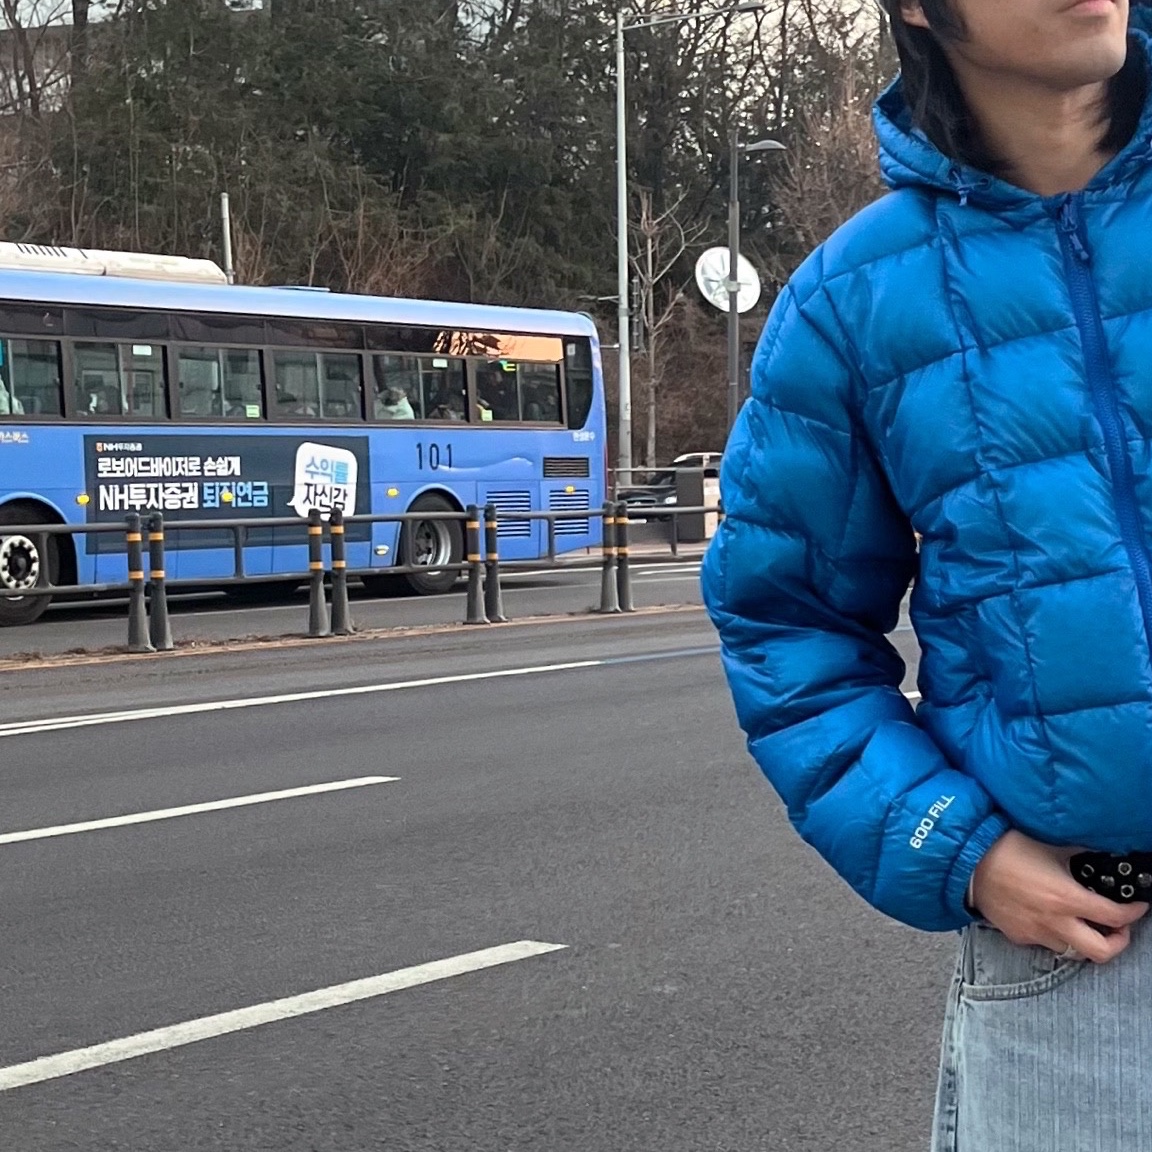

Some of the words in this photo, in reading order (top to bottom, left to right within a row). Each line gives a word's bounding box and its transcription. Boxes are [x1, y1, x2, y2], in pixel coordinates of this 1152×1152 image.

[97, 456, 202, 477] 로보어드바이저로
[203, 455, 241, 477] 손쉽게
[304, 456, 349, 485] 수익률
[416, 442, 453, 470] 101
[99, 481, 199, 511] NH투자증권
[202, 480, 269, 508] 퇴직연금
[303, 482, 348, 512] 자신감
[909, 817, 934, 849] 600
[928, 795, 956, 819] FILL
